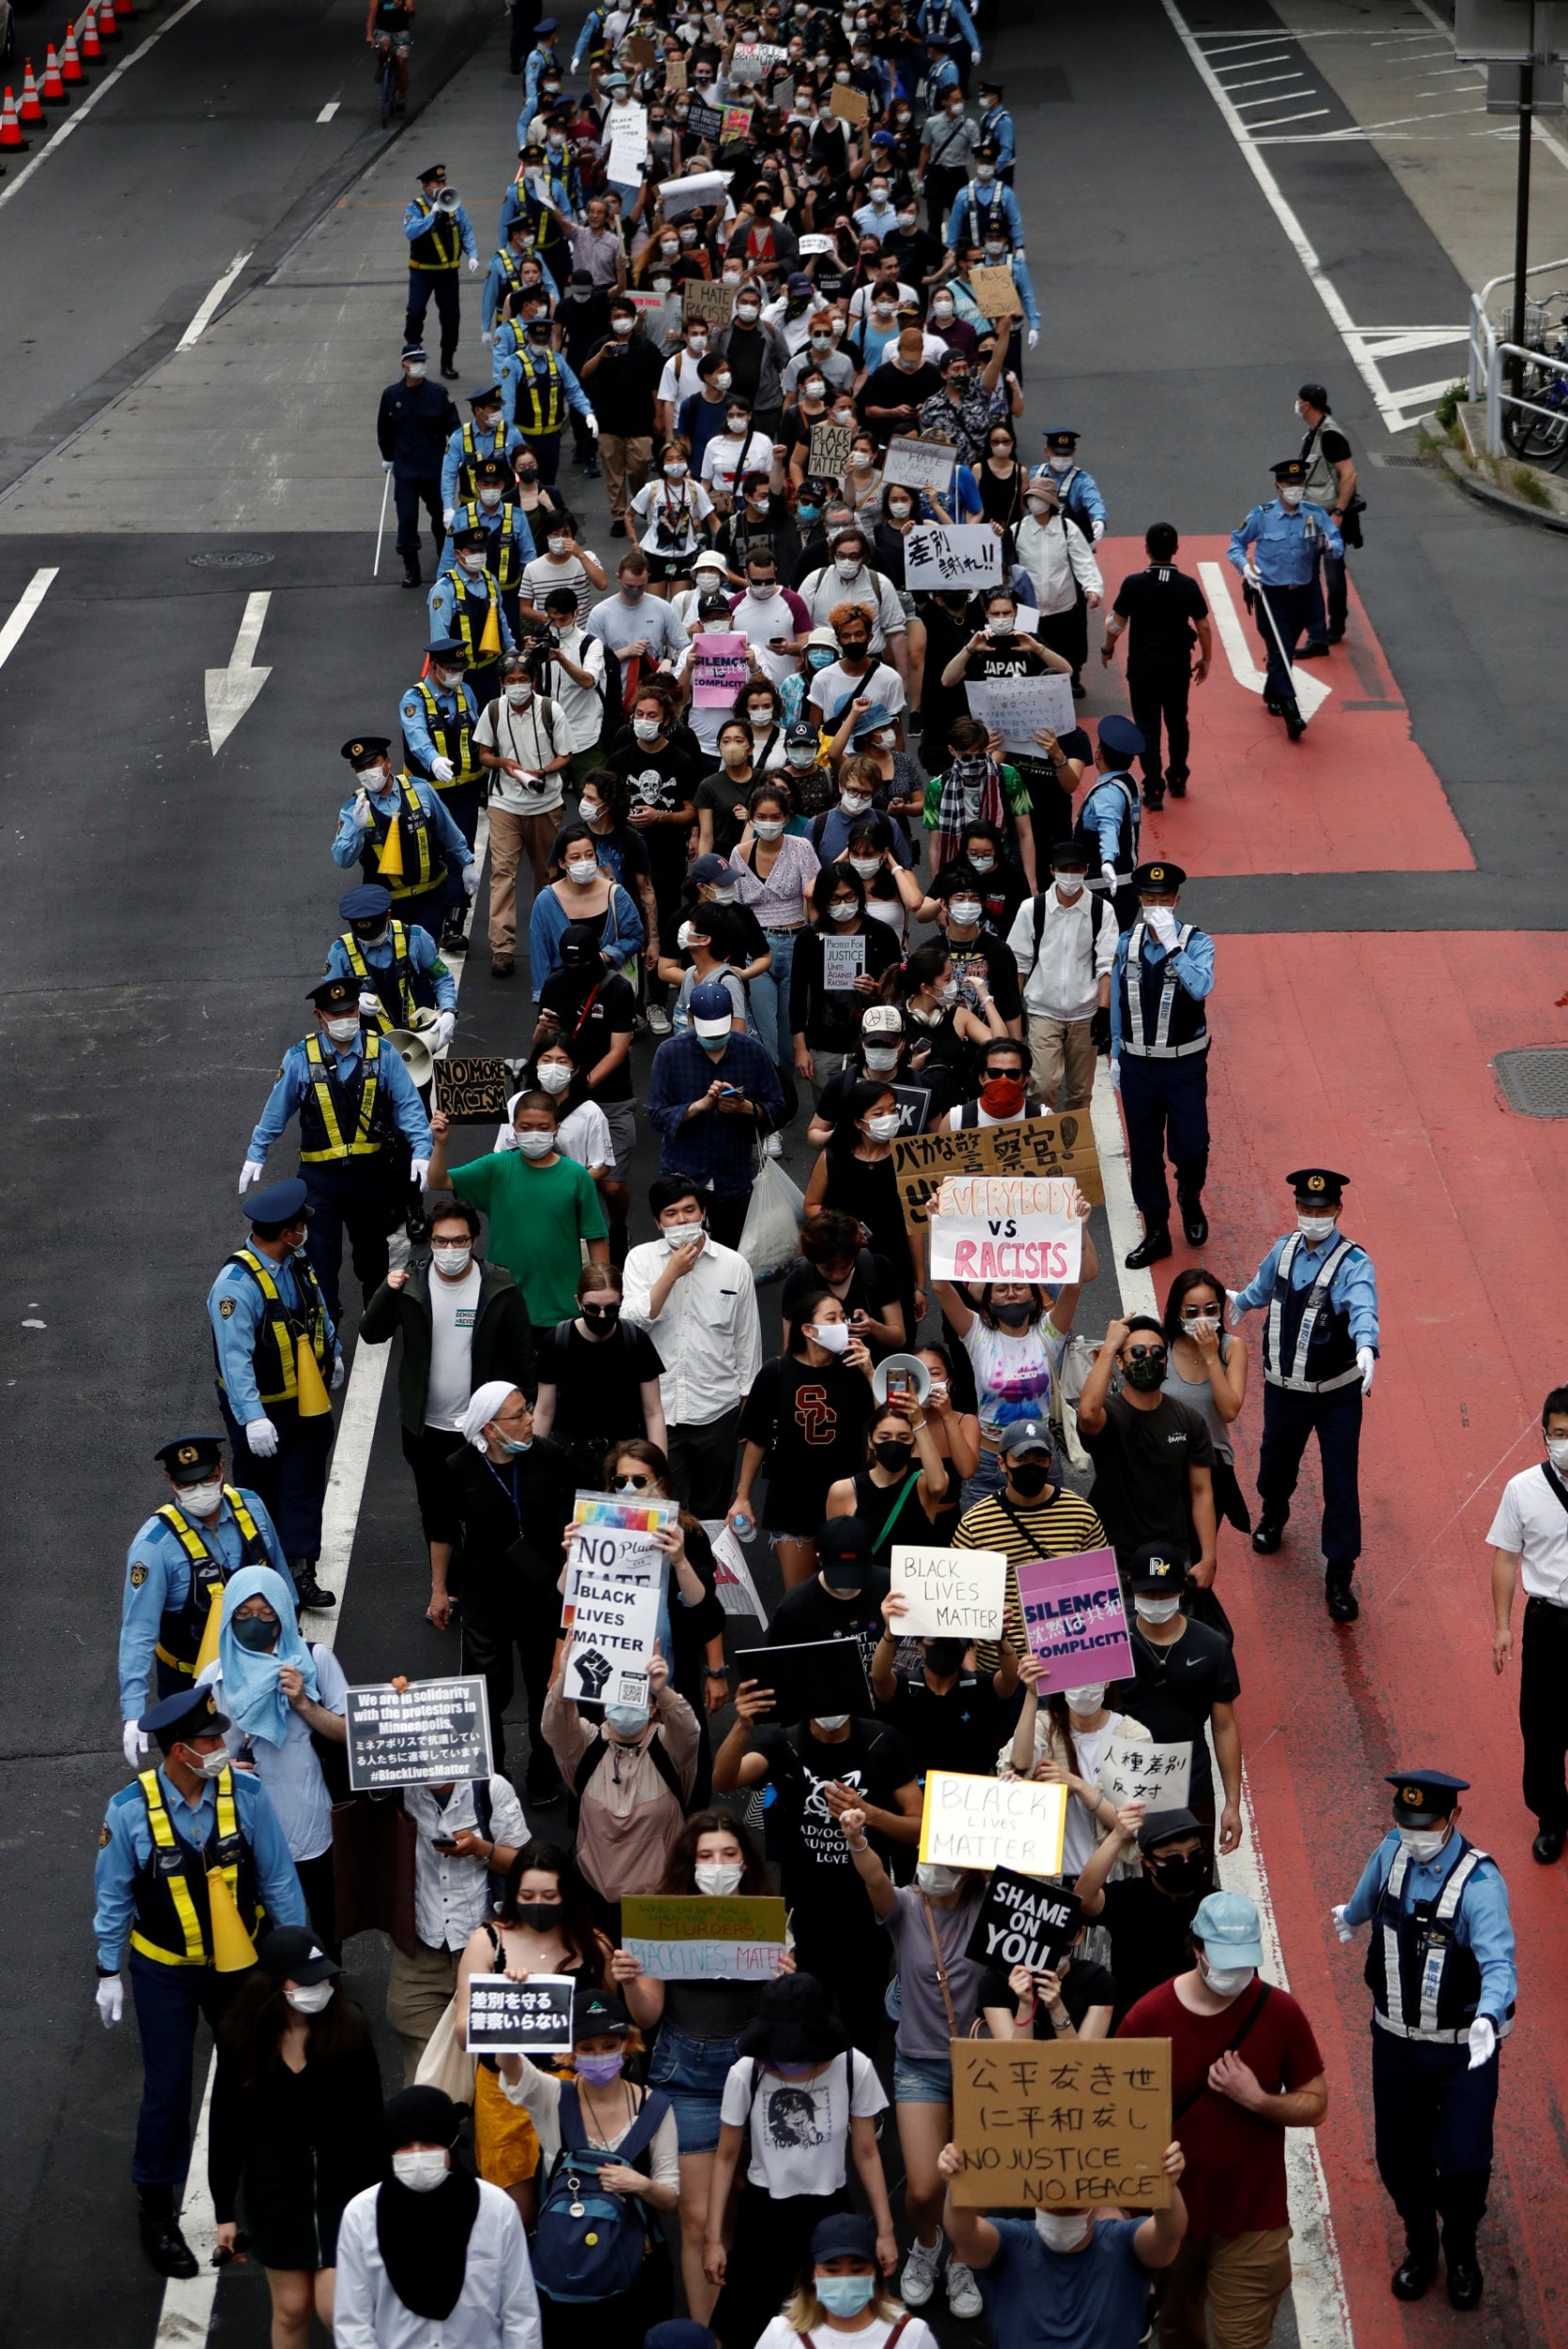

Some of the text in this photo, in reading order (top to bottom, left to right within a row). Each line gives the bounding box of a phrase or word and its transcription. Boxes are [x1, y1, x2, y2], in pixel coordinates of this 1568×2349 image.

[687, 285, 732, 305] I HATE
[686, 302, 731, 325] RACISTS
[813, 426, 850, 444] BLACK
[812, 443, 849, 459] LIVES
[810, 457, 846, 475] MATTER
[908, 530, 951, 568] 差別
[984, 661, 1027, 675] JAPAN
[828, 951, 863, 961] JUSTICE
[435, 1059, 505, 1086] NO MORE
[439, 1085, 508, 1115] RACISM
[939, 1177, 1078, 1220] EVERYBODY
[955, 1239, 1068, 1279] RACISTS
[578, 1536, 616, 1566] NO
[905, 1557, 960, 1579] BLACK
[581, 1585, 636, 1605] BLACK
[924, 1581, 979, 1601] LIVES
[577, 1608, 625, 1626] LIVES
[937, 1607, 998, 1629] MATTER
[573, 1630, 644, 1652] MATTER
[358, 1687, 470, 1706] We are in solidarity
[353, 1701, 476, 1721] with the protestors in
[379, 1718, 454, 1735] Minneapolis.
[355, 1732, 481, 1750] ミネアポリスで抗議してい
[356, 1746, 481, 1766] る人たちに連帯しています
[1104, 1746, 1187, 1776] 人種差別
[370, 1763, 470, 1781] #BlackLivesMatter
[1112, 1777, 1162, 1799] 反対
[941, 1780, 1047, 1820] BLACK
[967, 1816, 1016, 1830] LIVES
[934, 1833, 1037, 1859] MATTER
[816, 1852, 848, 1864] LOVE
[993, 1882, 1071, 1927] SHAME
[1010, 1912, 1042, 1938] ON
[630, 1941, 676, 1971] BLACK
[986, 1922, 1051, 1972] YOU
[1424, 1959, 1440, 1998] 警視庁
[472, 1991, 552, 2010] 差別を守る
[471, 2012, 567, 2030] 警察いらない
[968, 2058, 1160, 2096] 公平なき世
[980, 2103, 1147, 2139] に平和なし
[962, 2147, 1121, 2172] NO JUSTICE
[1023, 2175, 1161, 2202] NO PEACE
